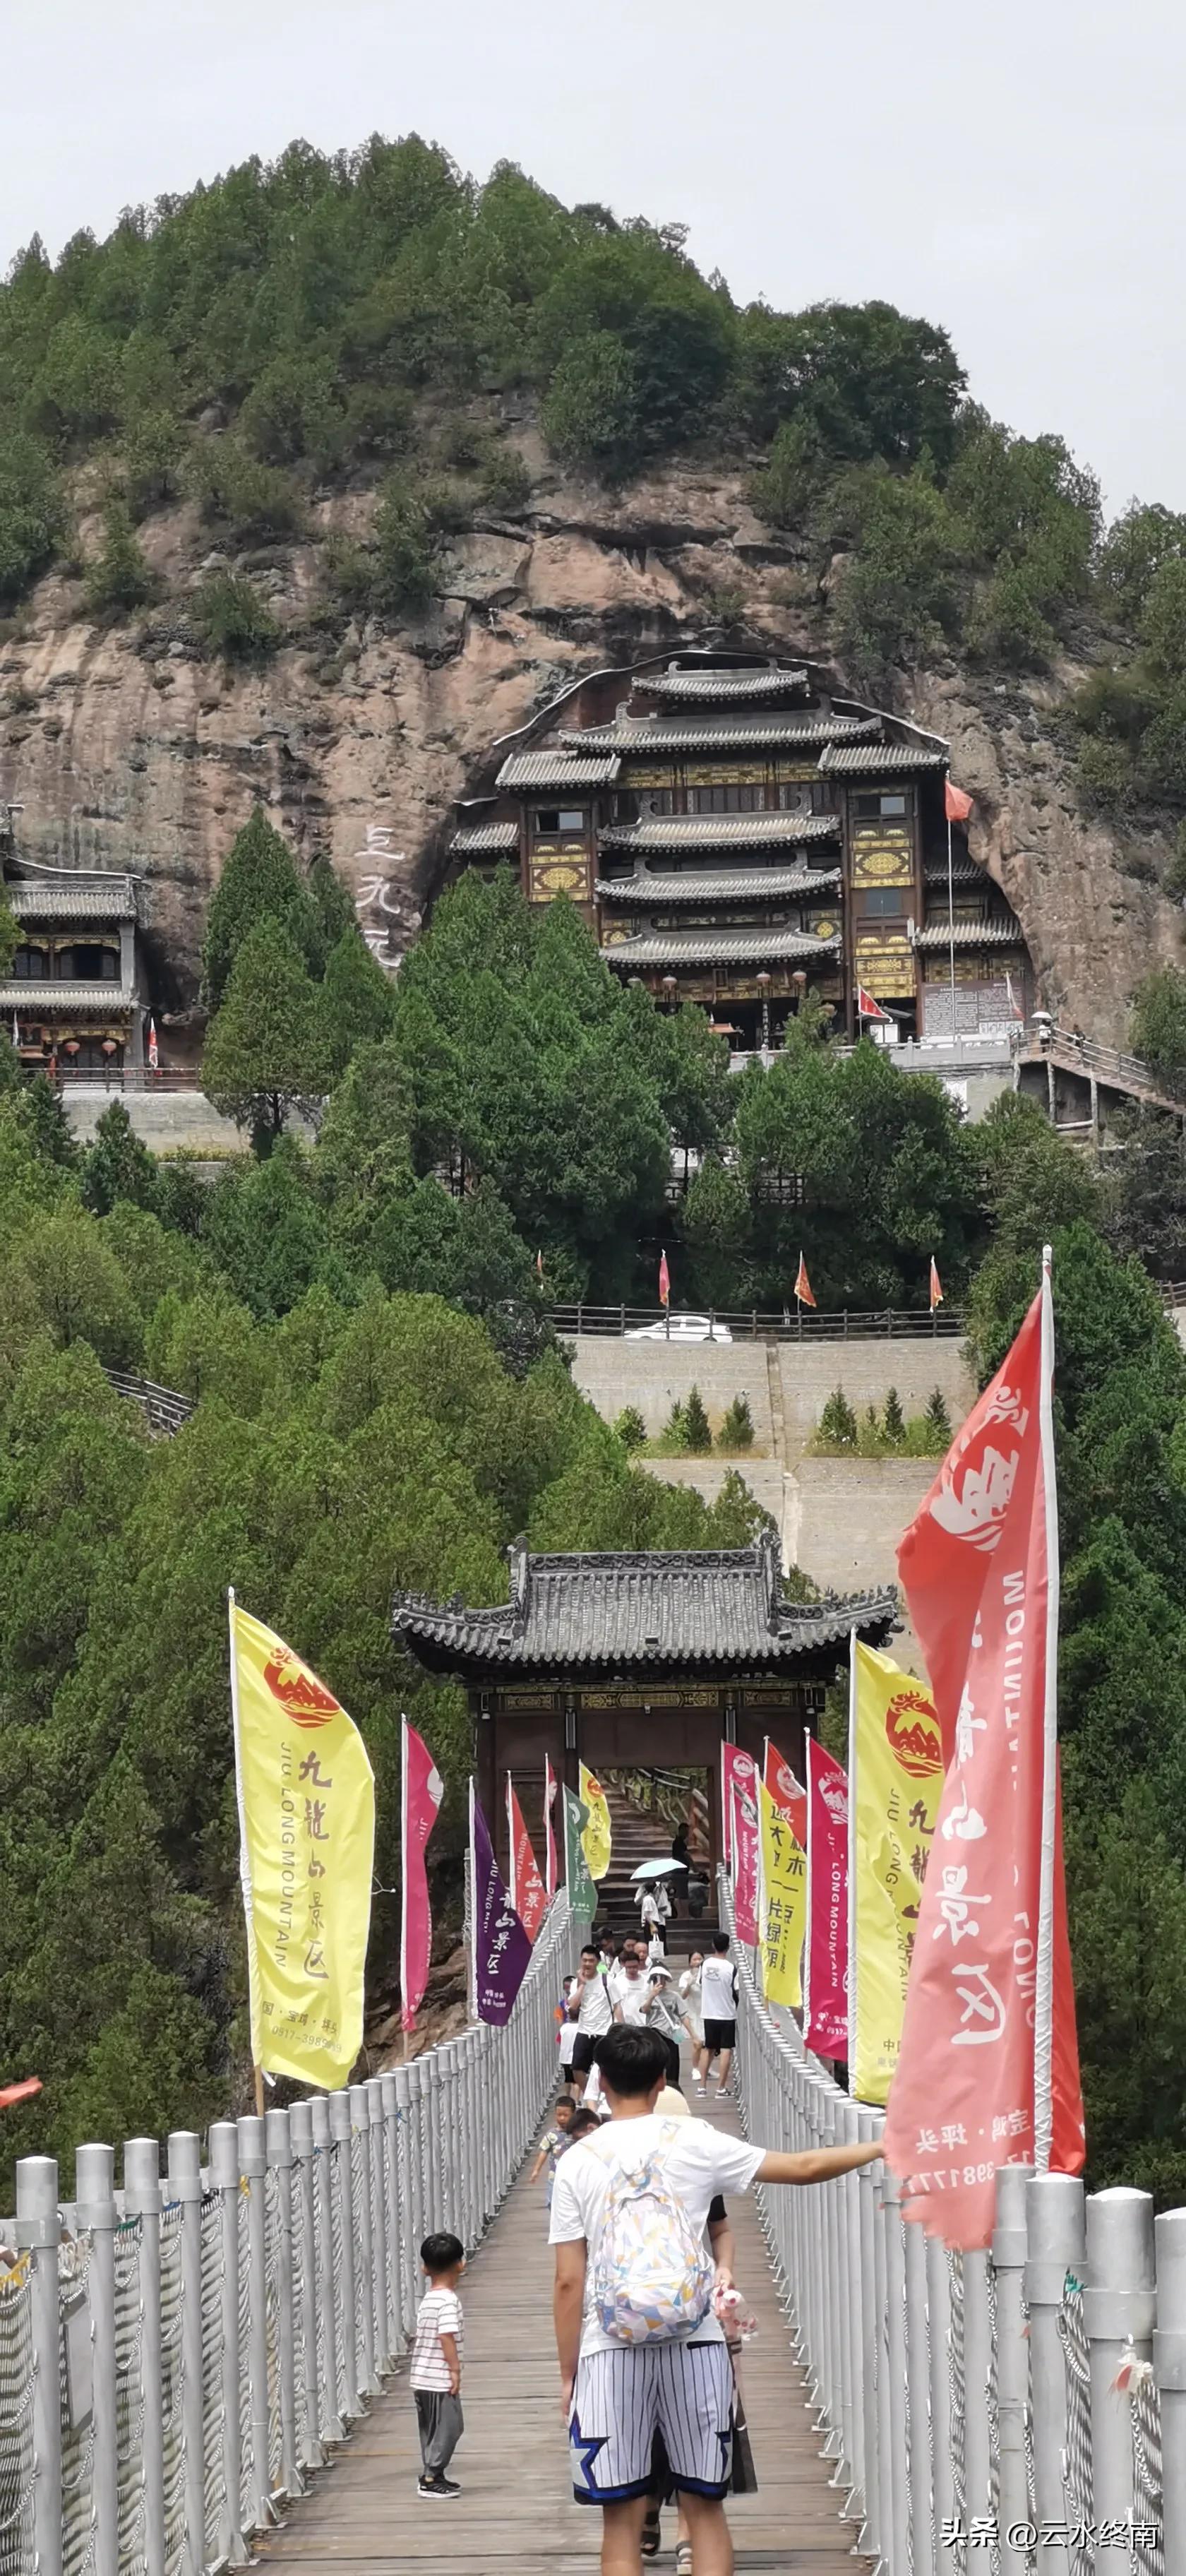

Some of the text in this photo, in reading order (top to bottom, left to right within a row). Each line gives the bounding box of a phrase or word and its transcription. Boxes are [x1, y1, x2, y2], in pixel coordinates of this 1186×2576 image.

[887, 1789, 900, 1822] JIU
[275, 1741, 295, 1967] JIU LONG MOUNTAIN
[886, 1831, 902, 1885] LONG
[485, 1880, 496, 1910] LONG
[831, 1862, 841, 1903] LONG
[828, 1907, 839, 1988] MOUNTAIN
[883, 2038, 901, 2053] 中
